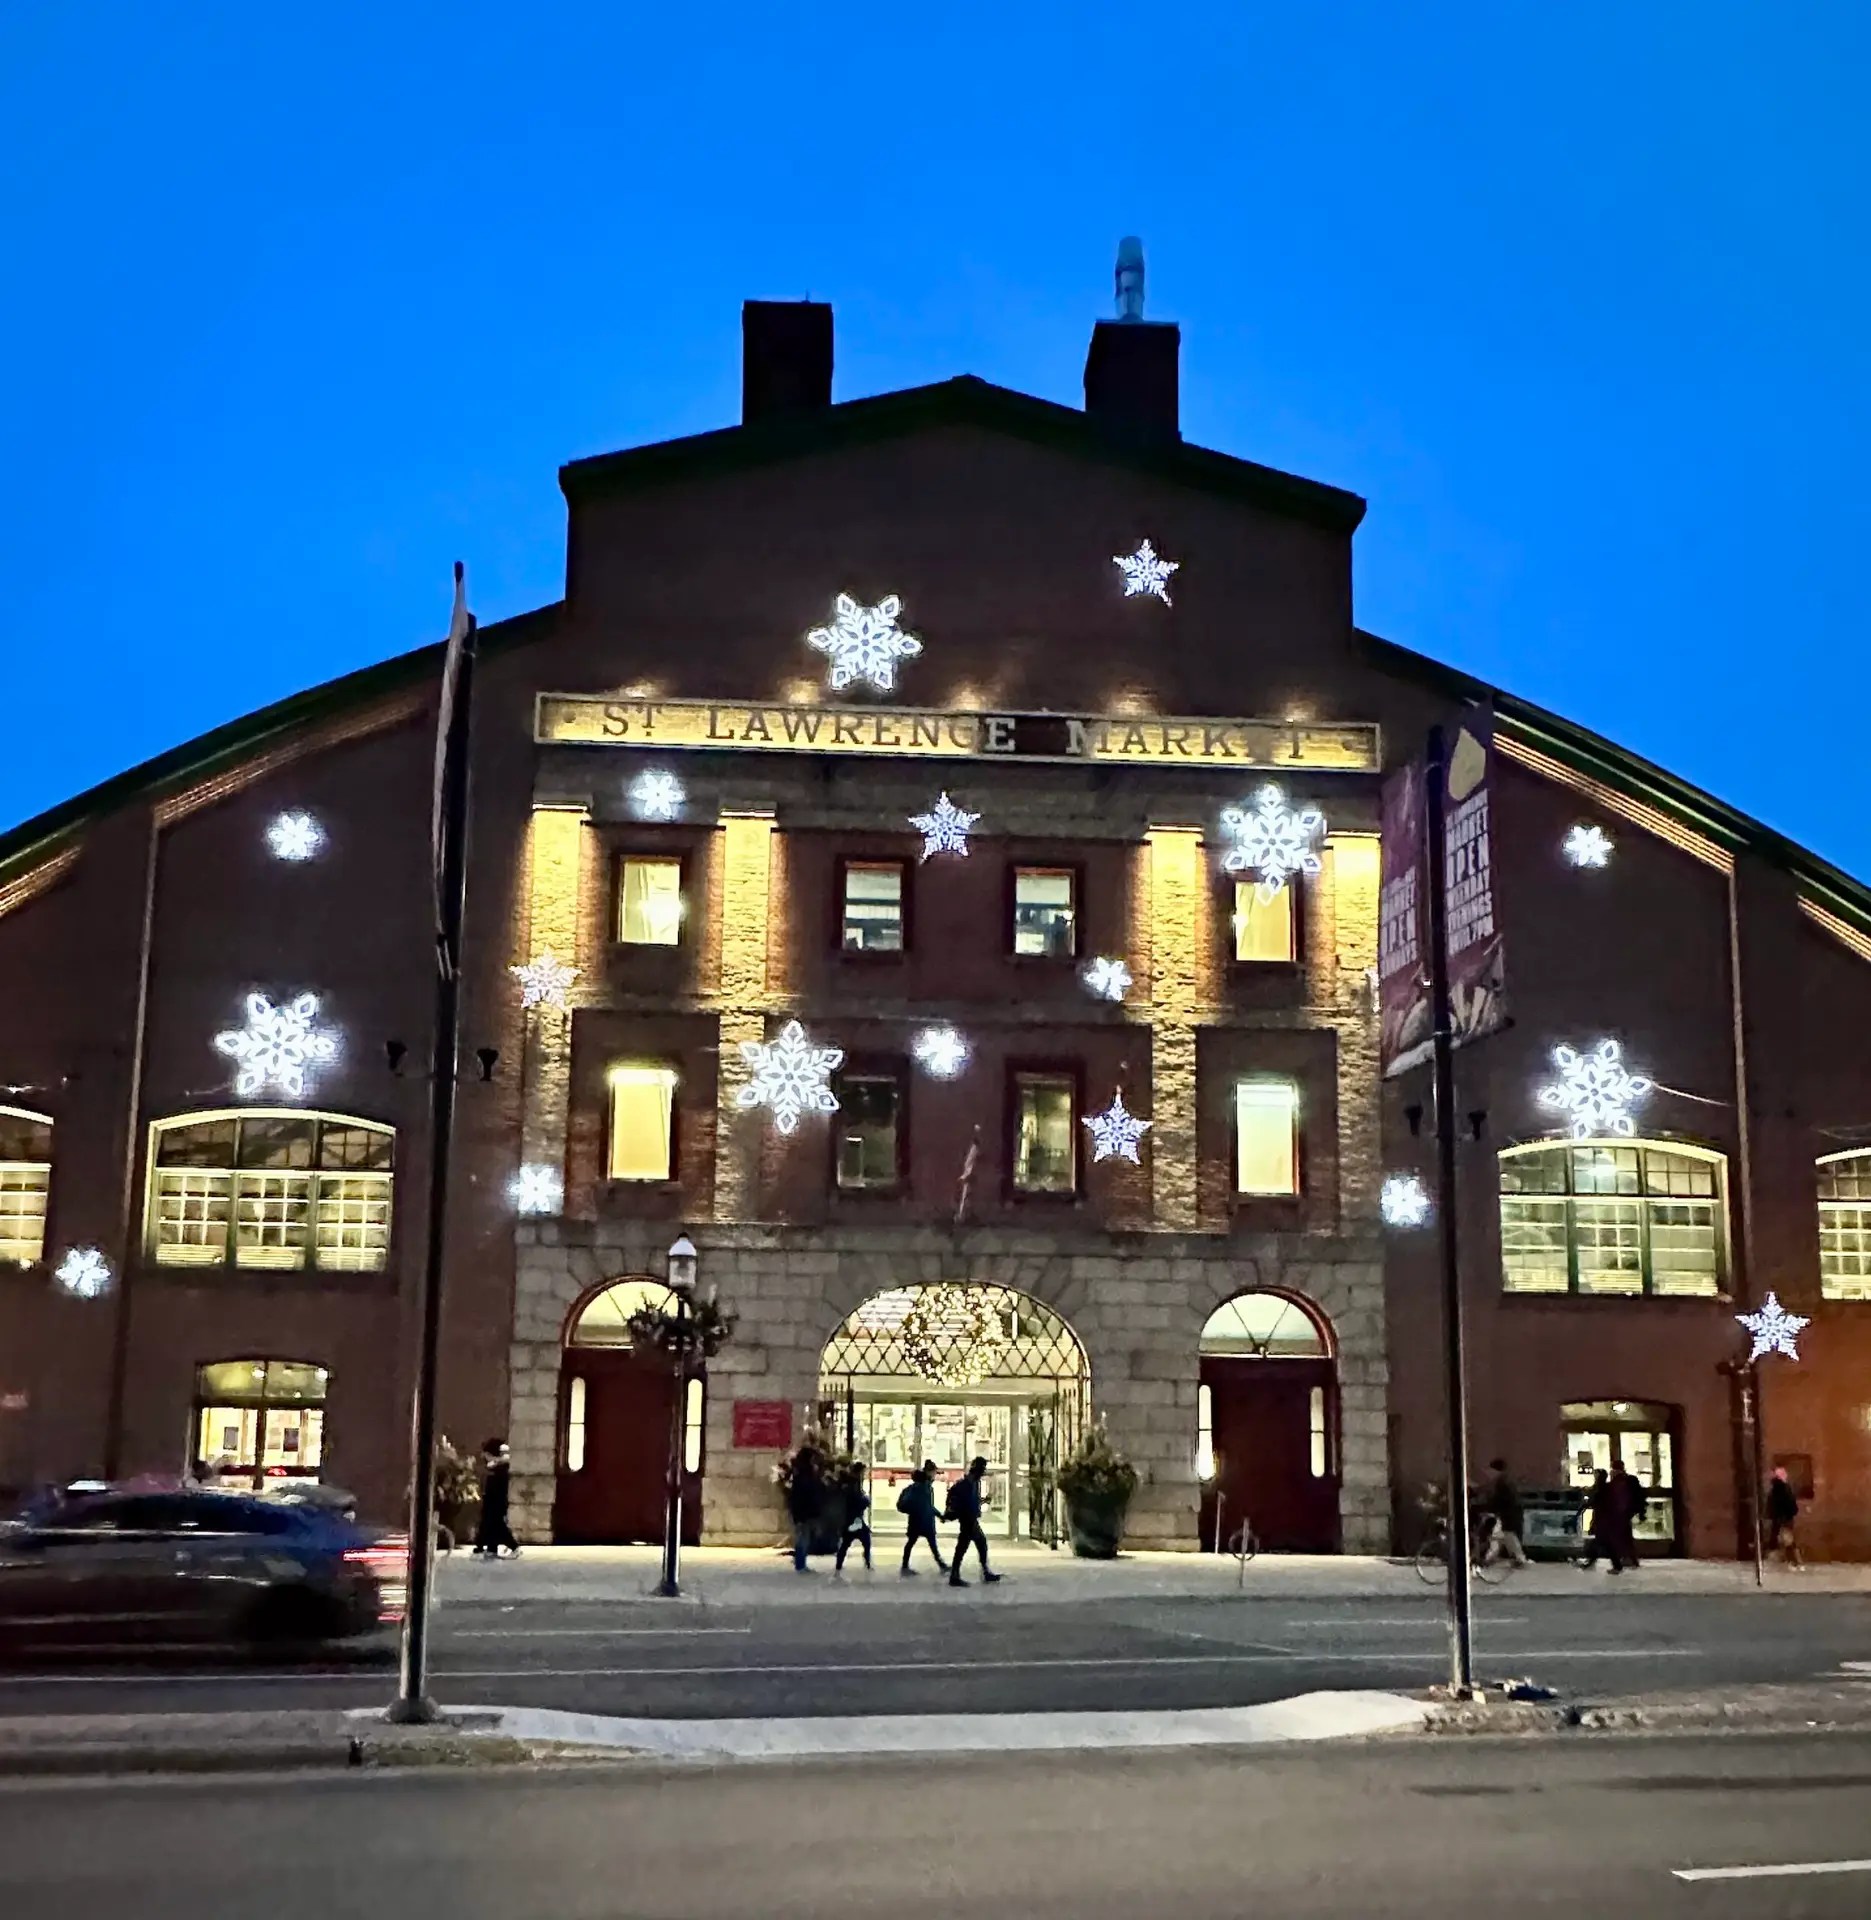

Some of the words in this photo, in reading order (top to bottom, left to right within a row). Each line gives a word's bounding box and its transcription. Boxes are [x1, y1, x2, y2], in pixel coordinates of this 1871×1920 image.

[705, 706, 1016, 753] LAWRENCE
[1065, 719, 1311, 760] MARKT
[1445, 832, 1490, 889] OPEN
